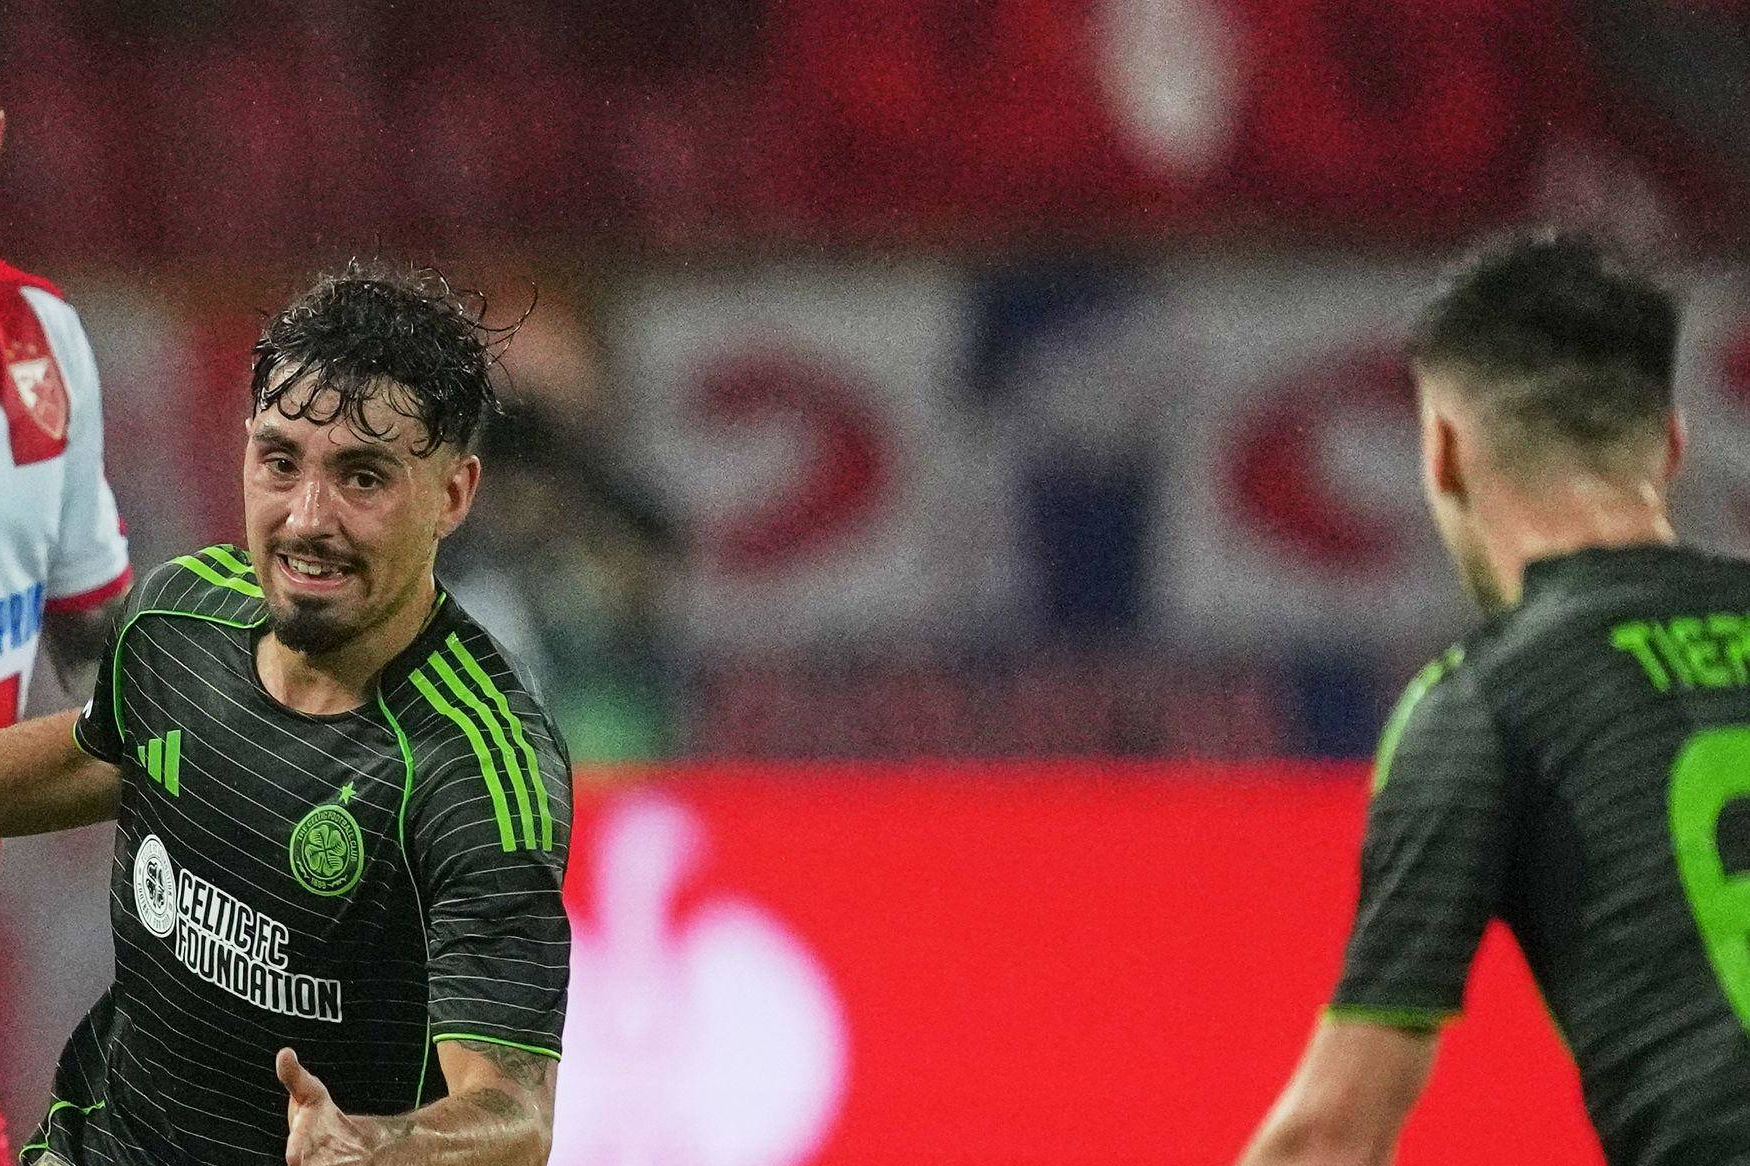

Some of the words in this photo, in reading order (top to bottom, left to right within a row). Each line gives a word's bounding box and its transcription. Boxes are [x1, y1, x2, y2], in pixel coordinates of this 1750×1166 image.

[175, 914, 343, 1024] FOUNDATION
[176, 868, 255, 953] CELTIC
[252, 911, 290, 970] FC
